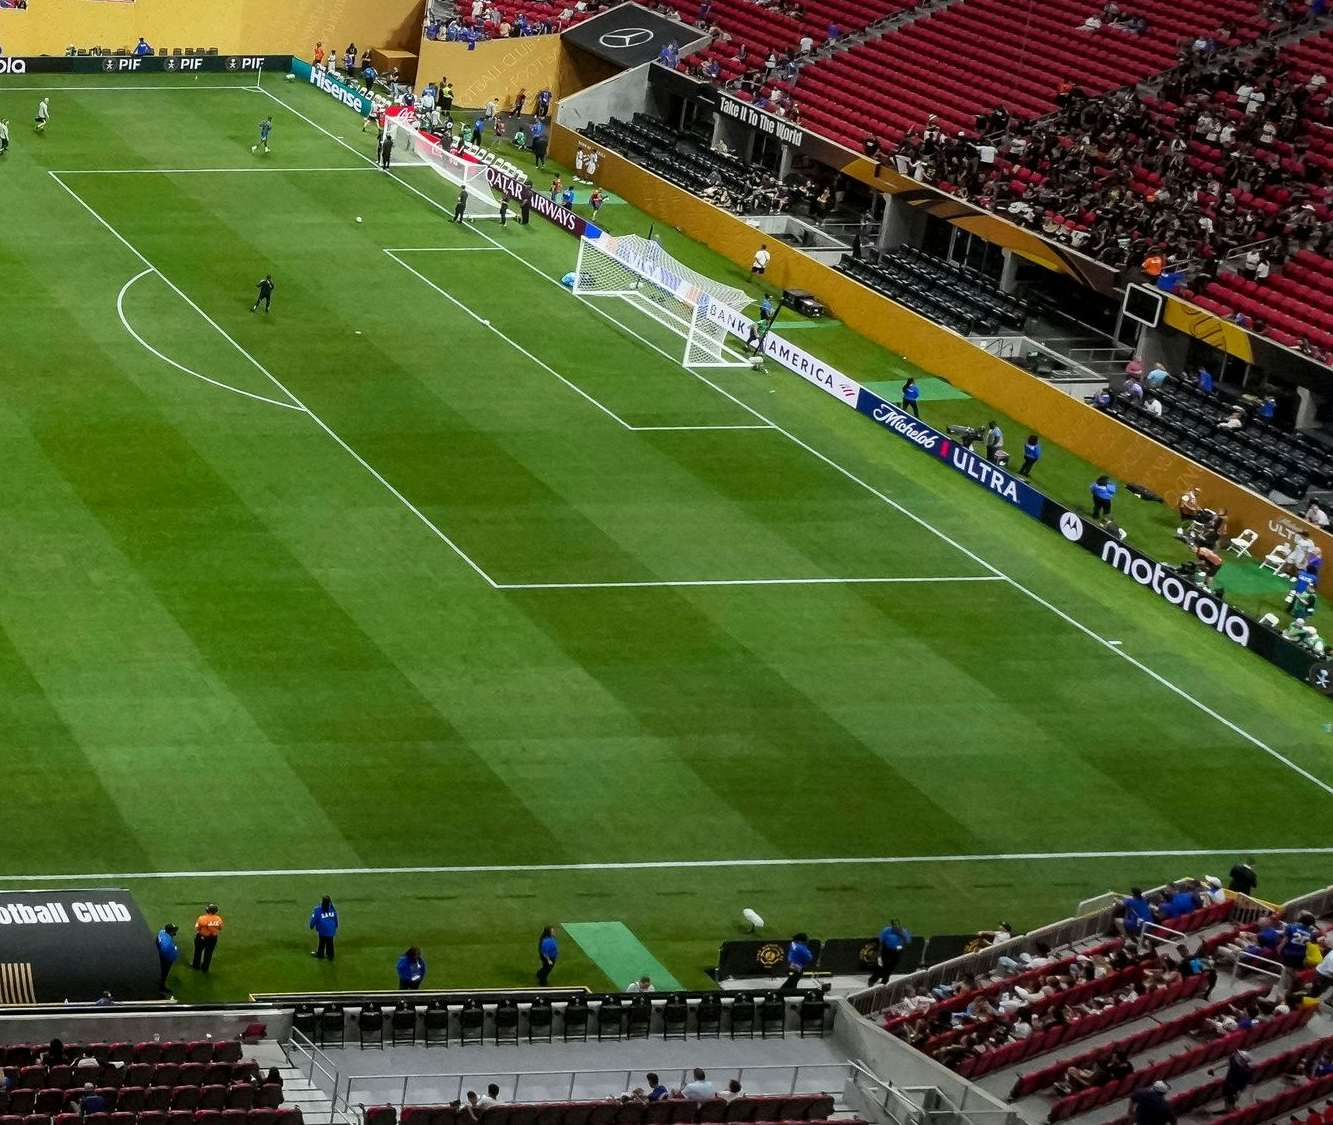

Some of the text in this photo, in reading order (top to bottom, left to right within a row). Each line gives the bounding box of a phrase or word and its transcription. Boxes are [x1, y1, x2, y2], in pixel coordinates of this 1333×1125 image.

[119, 58, 141, 71] PIF
[180, 57, 203, 70] PIF
[242, 56, 265, 70] PIF
[309, 65, 363, 113] Hisense
[720, 96, 803, 147] Take It To The World
[484, 166, 524, 202] QATAR
[710, 303, 834, 390] BANK AMERICA
[872, 401, 1020, 504] Michelob ULTRA
[1101, 539, 1250, 648] motorola
[72, 901, 132, 923] Club
